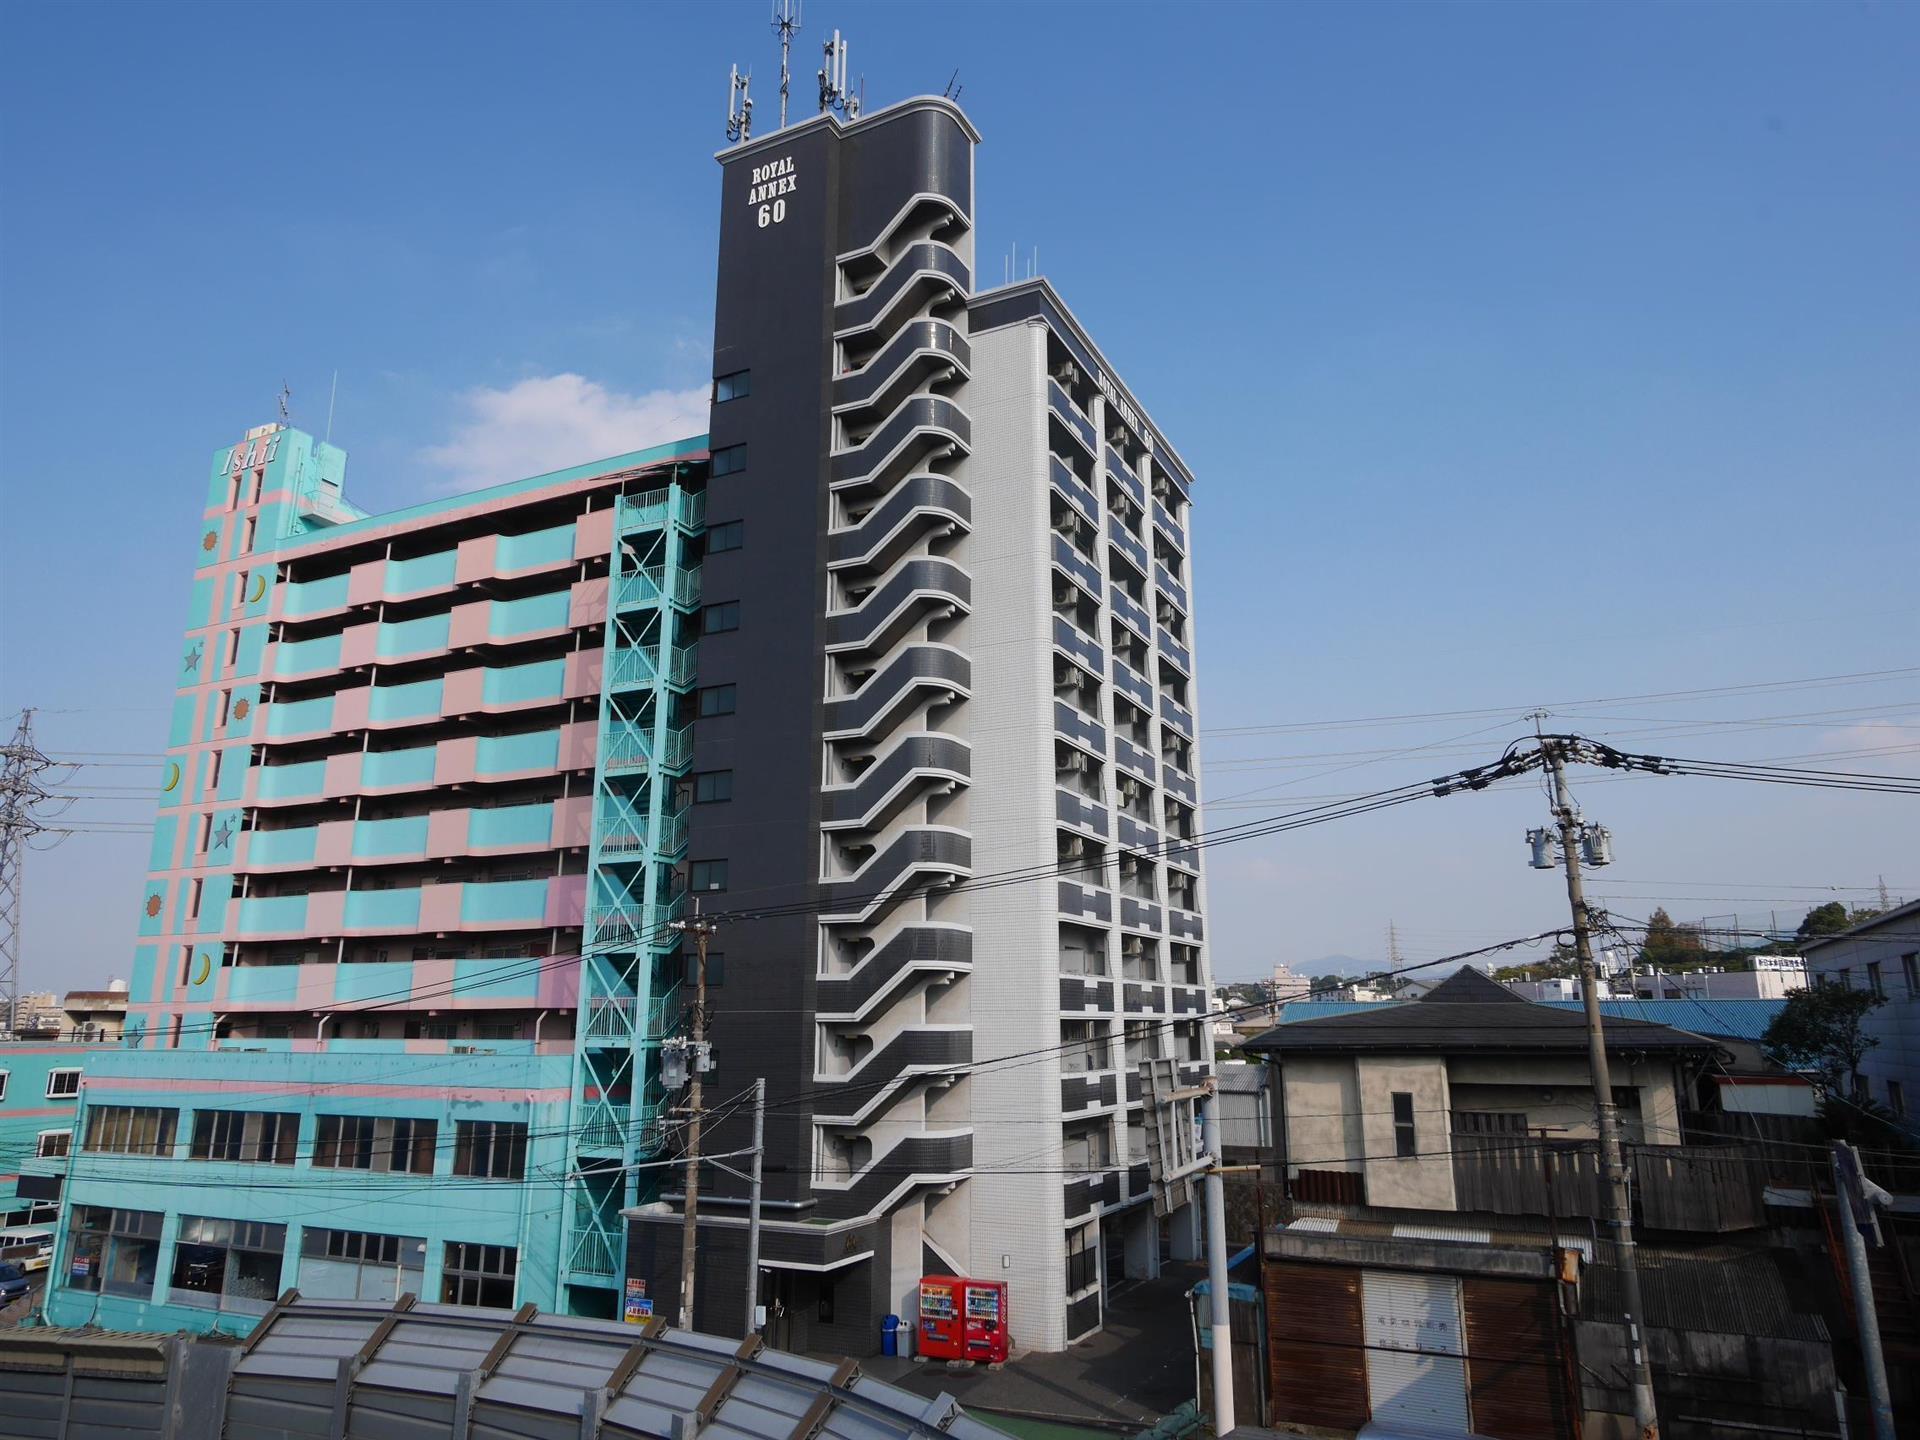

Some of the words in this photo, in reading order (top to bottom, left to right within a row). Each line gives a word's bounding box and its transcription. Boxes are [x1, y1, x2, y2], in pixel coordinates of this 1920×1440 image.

[752, 156, 794, 185] ROYAL
[748, 174, 797, 206] ANNEX
[758, 199, 786, 229] 60
[220, 436, 280, 476] Ishii
